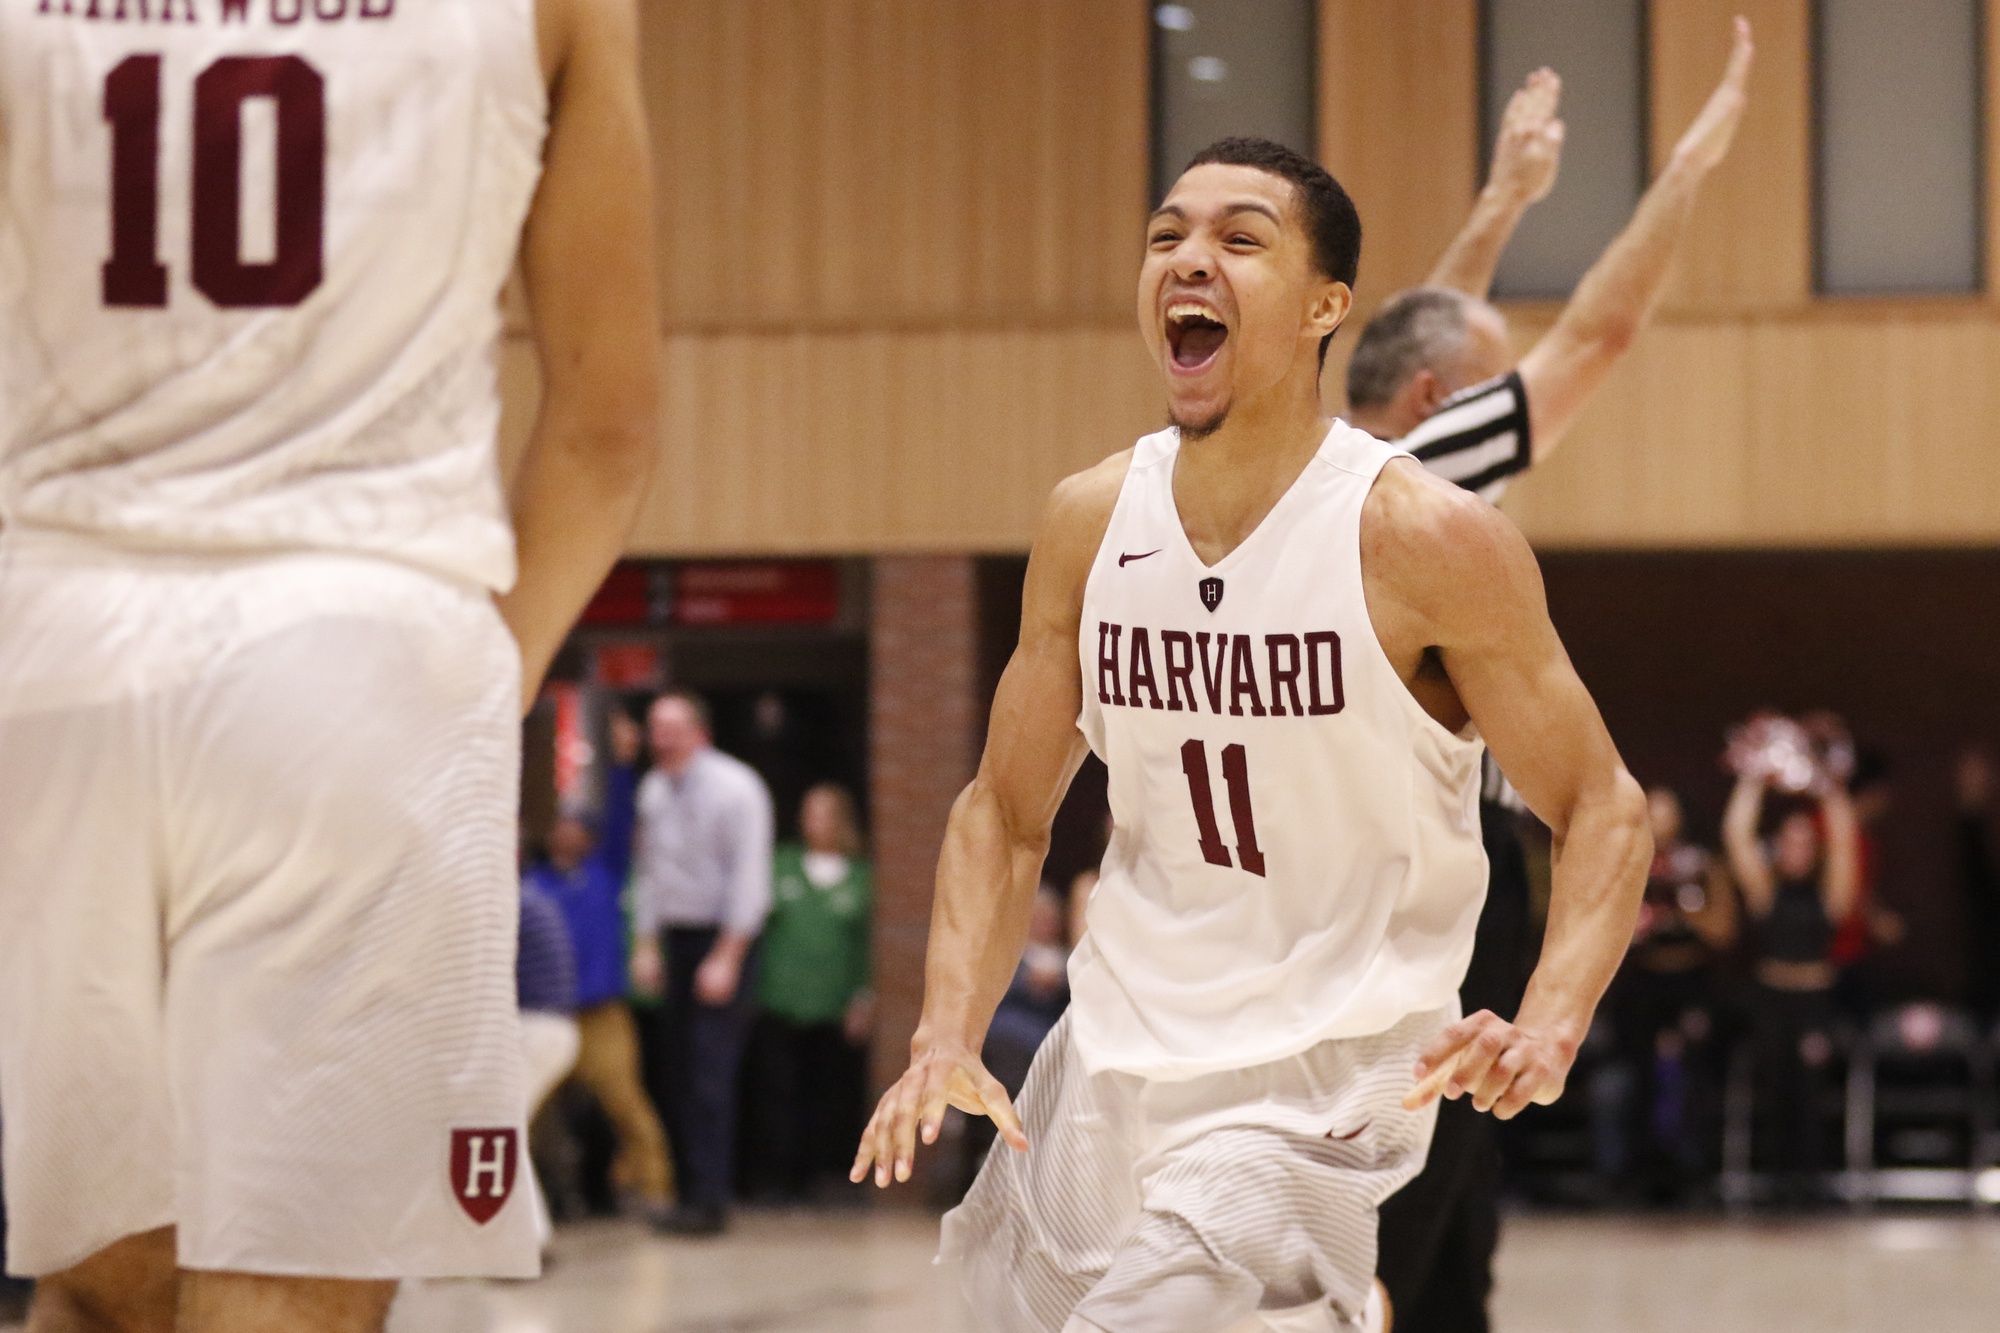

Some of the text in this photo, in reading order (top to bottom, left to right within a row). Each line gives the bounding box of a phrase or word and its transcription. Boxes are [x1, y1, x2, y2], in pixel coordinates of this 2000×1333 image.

[101, 54, 327, 310] 10
[1206, 584, 1217, 602] H
[1098, 621, 1346, 717] HARVARD
[1180, 738, 1266, 878] 11
[464, 1136, 508, 1198] H
